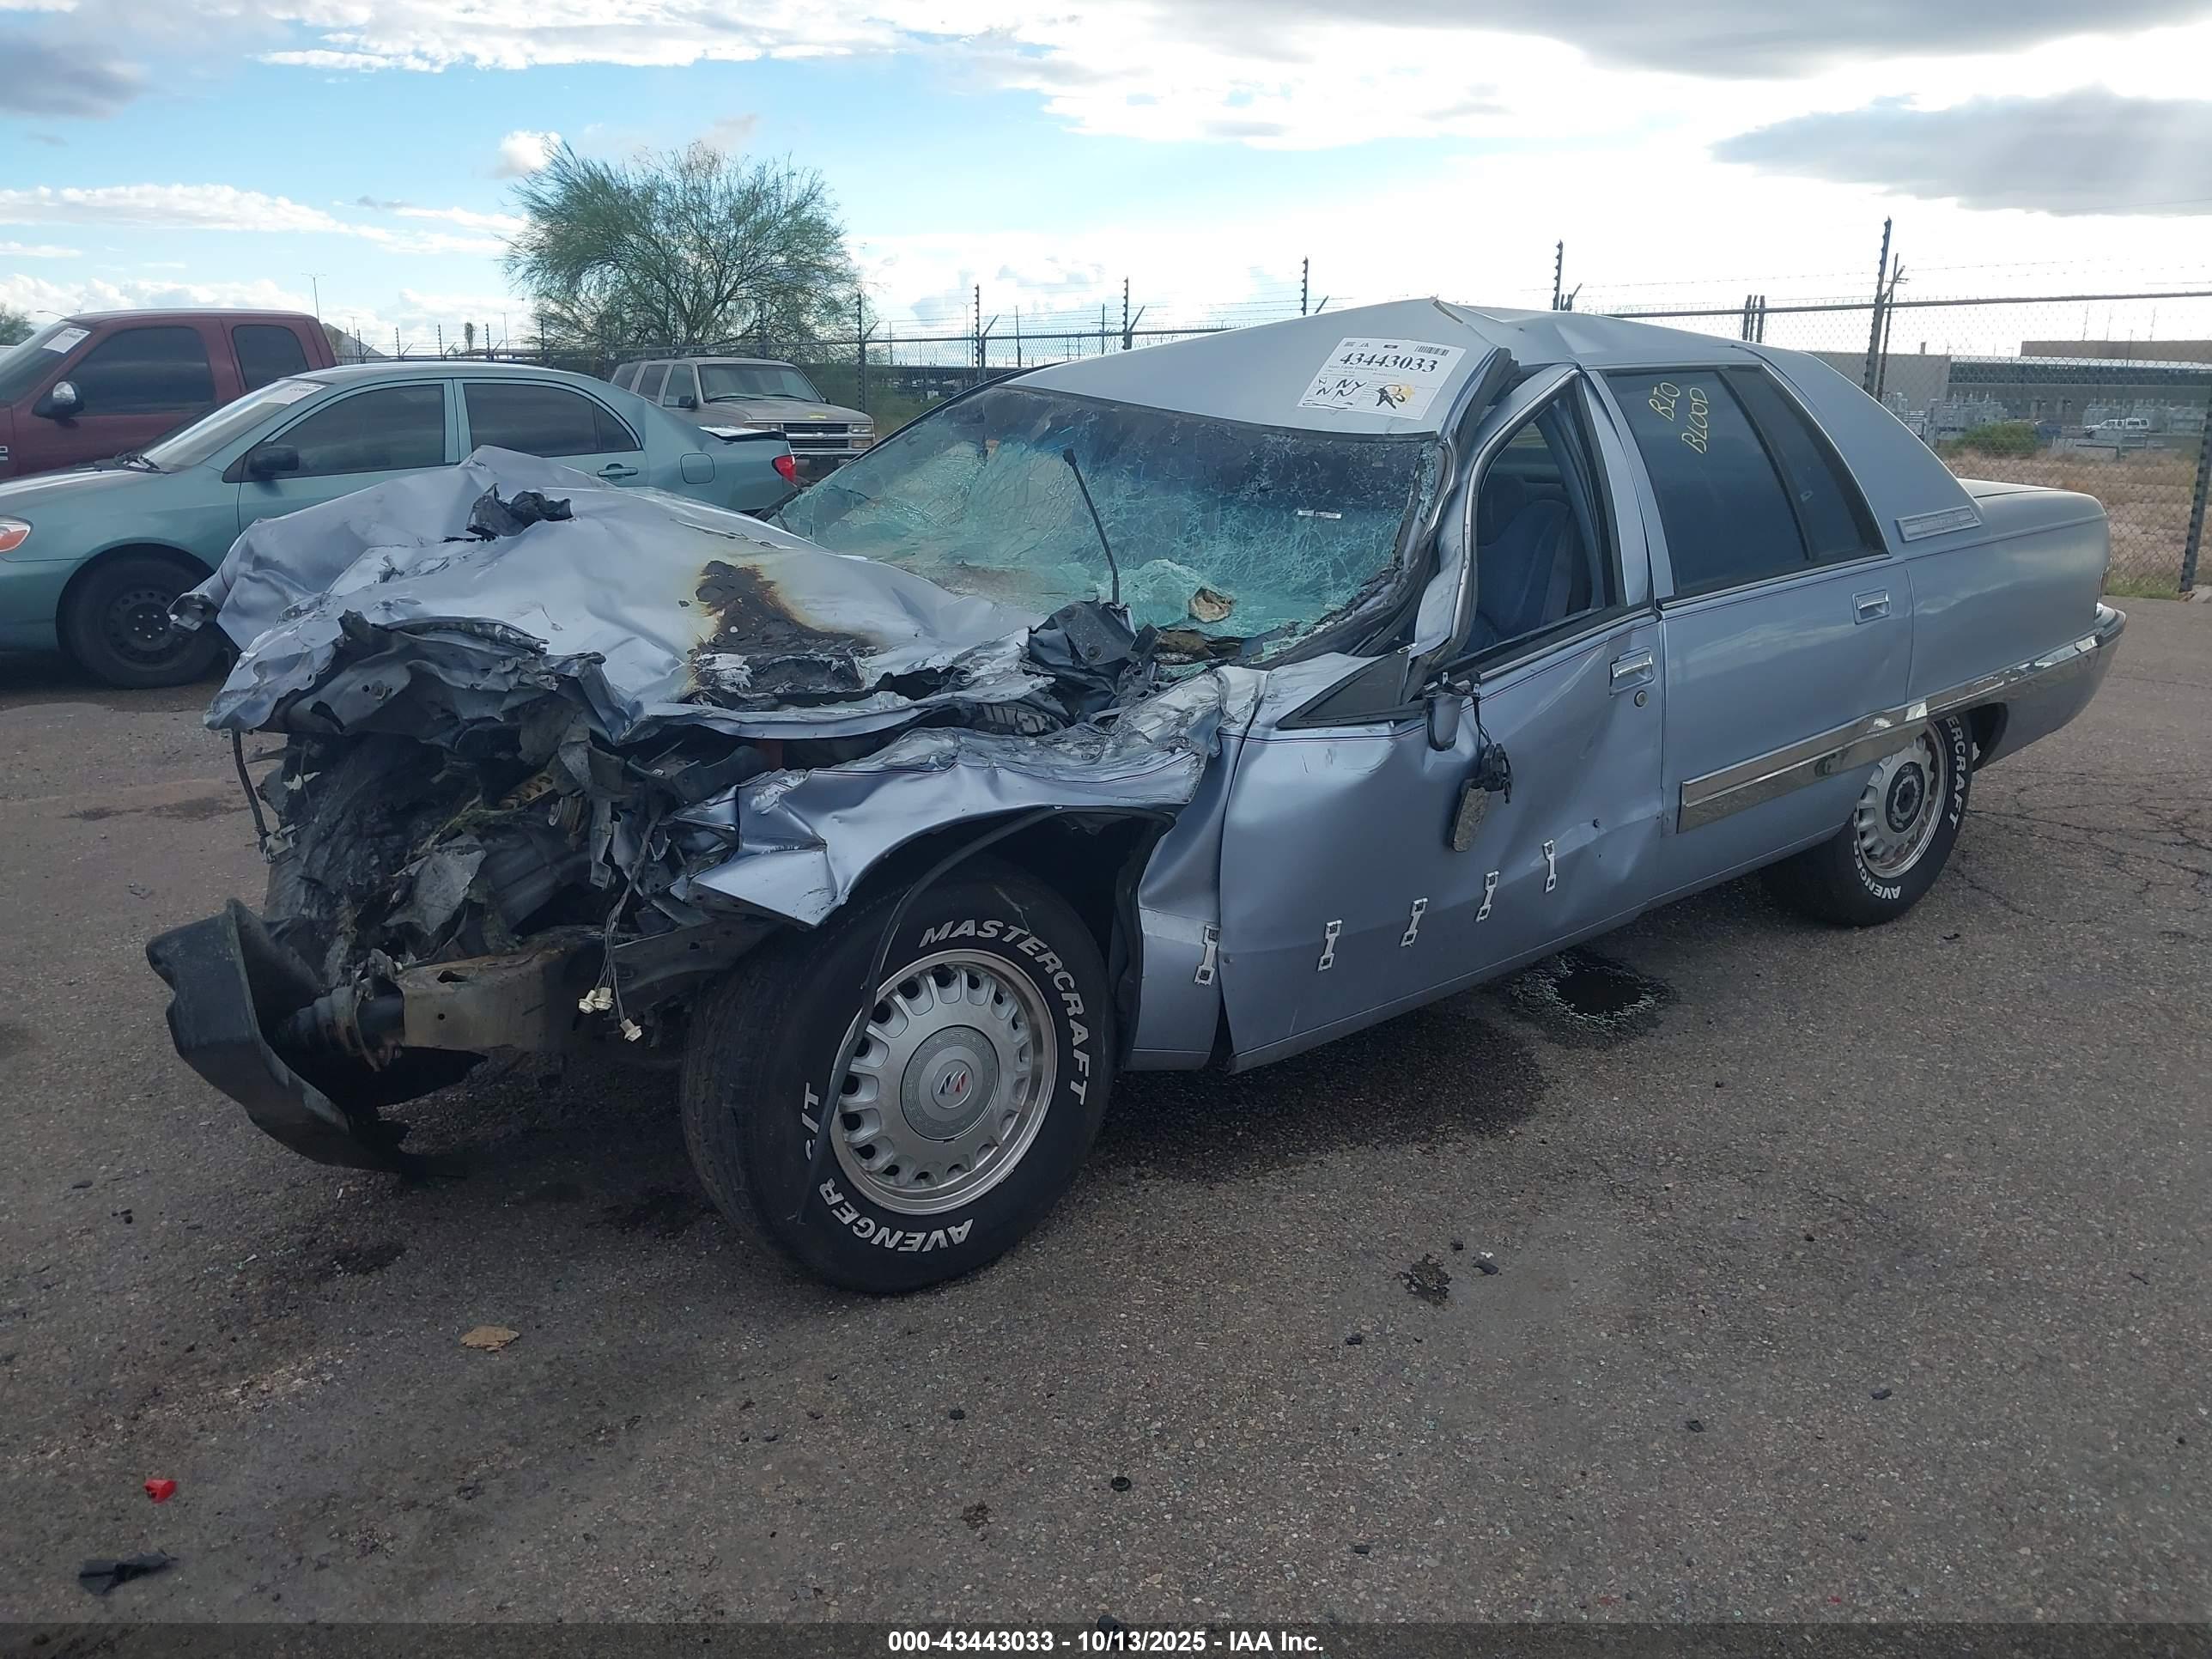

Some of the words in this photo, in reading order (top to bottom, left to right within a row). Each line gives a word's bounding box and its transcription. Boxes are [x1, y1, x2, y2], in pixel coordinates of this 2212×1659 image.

[1340, 352, 1438, 373] 43443033
[1649, 382, 1680, 422] BIO
[1946, 715, 1966, 830] ERCRAFT
[919, 920, 1090, 1106] MASTERCRAFT
[818, 1177, 974, 1253] AVENGER
